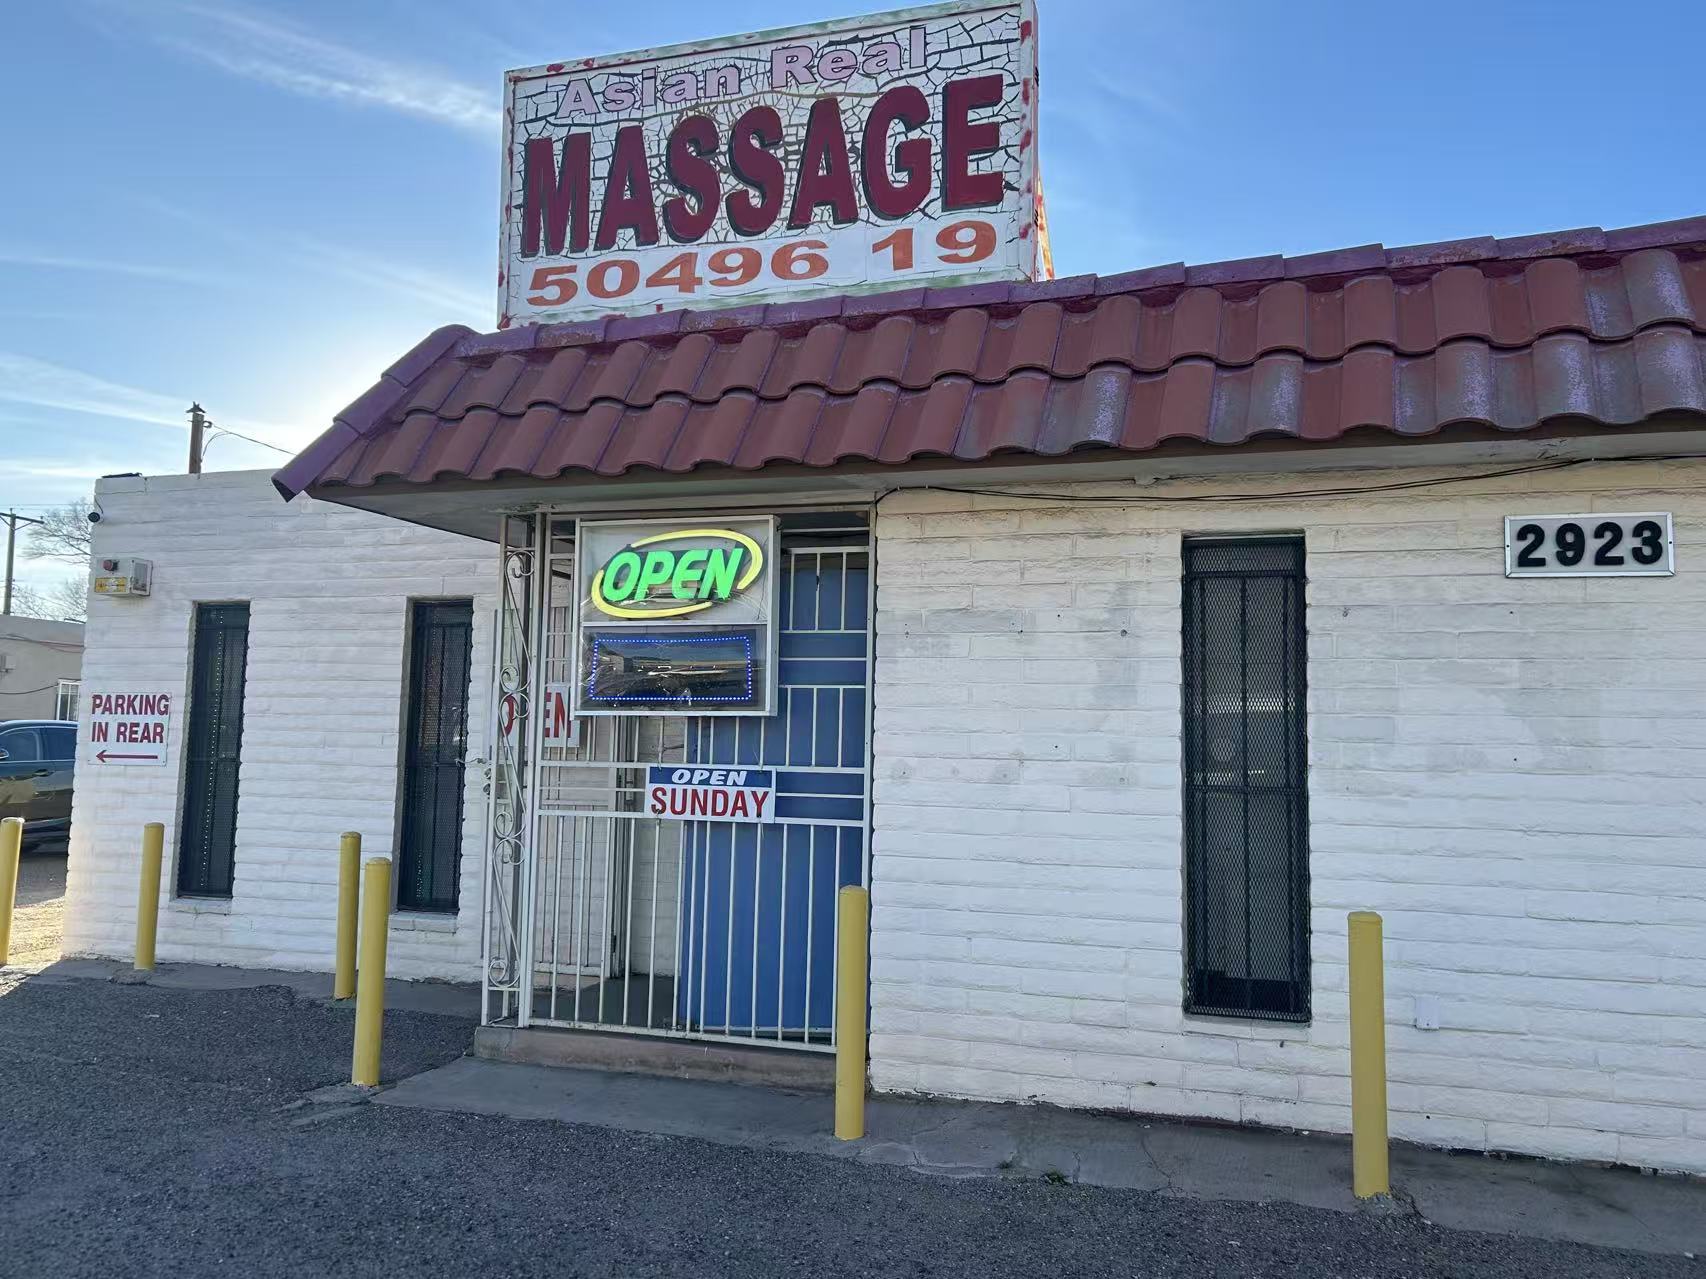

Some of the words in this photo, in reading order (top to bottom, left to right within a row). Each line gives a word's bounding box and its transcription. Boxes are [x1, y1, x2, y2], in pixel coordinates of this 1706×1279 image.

[556, 66, 740, 119] Asian
[770, 27, 928, 89] Real
[521, 75, 1004, 259] MASSAGE
[1516, 520, 1663, 567] 2923
[602, 548, 744, 601] OPEN
[91, 694, 169, 716] PARKING
[91, 722, 109, 742] IN
[116, 722, 165, 743] REAR
[671, 769, 748, 786] OPEN
[651, 787, 769, 818] SUNDAY
